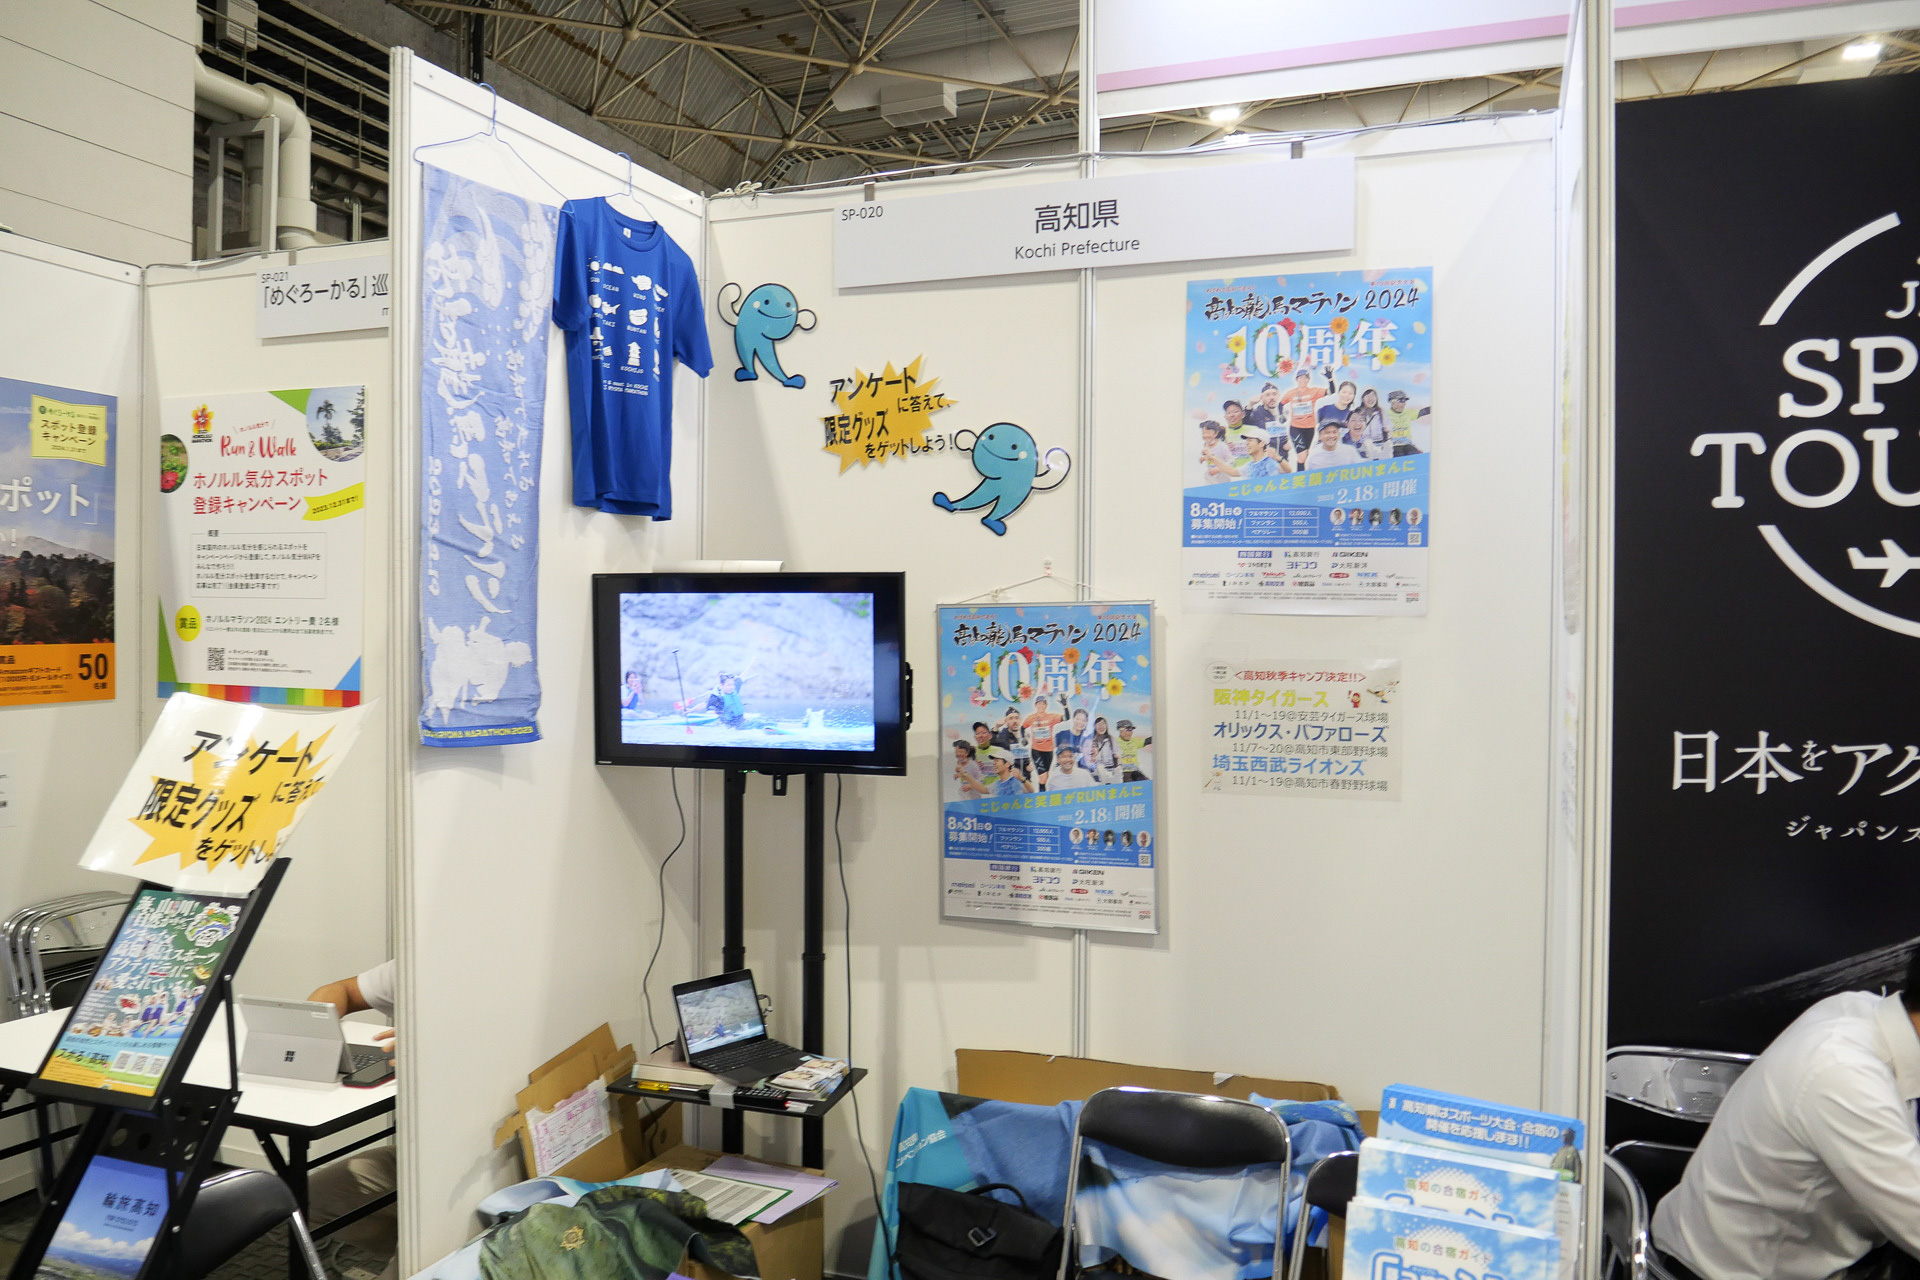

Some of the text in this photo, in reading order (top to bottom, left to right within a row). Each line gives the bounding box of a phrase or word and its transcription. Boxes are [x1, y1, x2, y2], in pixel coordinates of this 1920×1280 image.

[841, 205, 884, 221] SP-020
[1034, 199, 1120, 234] 高知県
[1014, 238, 1140, 260] Kochi Prefecture
[261, 271, 289, 284] SP-021
[1364, 287, 1420, 310] 2024
[1224, 318, 1400, 378] 10周年
[829, 367, 917, 403] アンケート
[40, 419, 97, 435] スポット登録
[41, 431, 97, 446] キャンペーン
[825, 408, 890, 448] 限定グッズ
[220, 435, 246, 458] Run
[259, 436, 297, 459] Walk
[865, 433, 954, 459] をゲットしよう!
[193, 467, 329, 489] ホノルル気分スポット
[1228, 460, 1417, 497] こじゃんと笑顔がRUNまんに
[1337, 485, 1374, 504] 2.18
[1382, 479, 1418, 499] 開催
[193, 496, 302, 515] 登録キャンペーン
[1093, 621, 1142, 643] 2024
[78, 653, 109, 681] 50
[974, 651, 1127, 701] 10周年
[1213, 688, 1329, 708] 阪神タイガース
[1213, 721, 1389, 743] オリックス・バファローズ
[183, 730, 315, 778] アンケート
[1212, 753, 1367, 776] 埼玉西武ライオンズ
[137, 777, 263, 832] 限定グッズ
[1402, 1100, 1560, 1139] 高知県はスポーツ大会・合宿の
[1425, 1118, 1530, 1149] 開催を応援します!!
[1406, 1177, 1503, 1205] 高知の合宿ガイド
[1394, 1236, 1492, 1265] 高知の合宿ガイド
